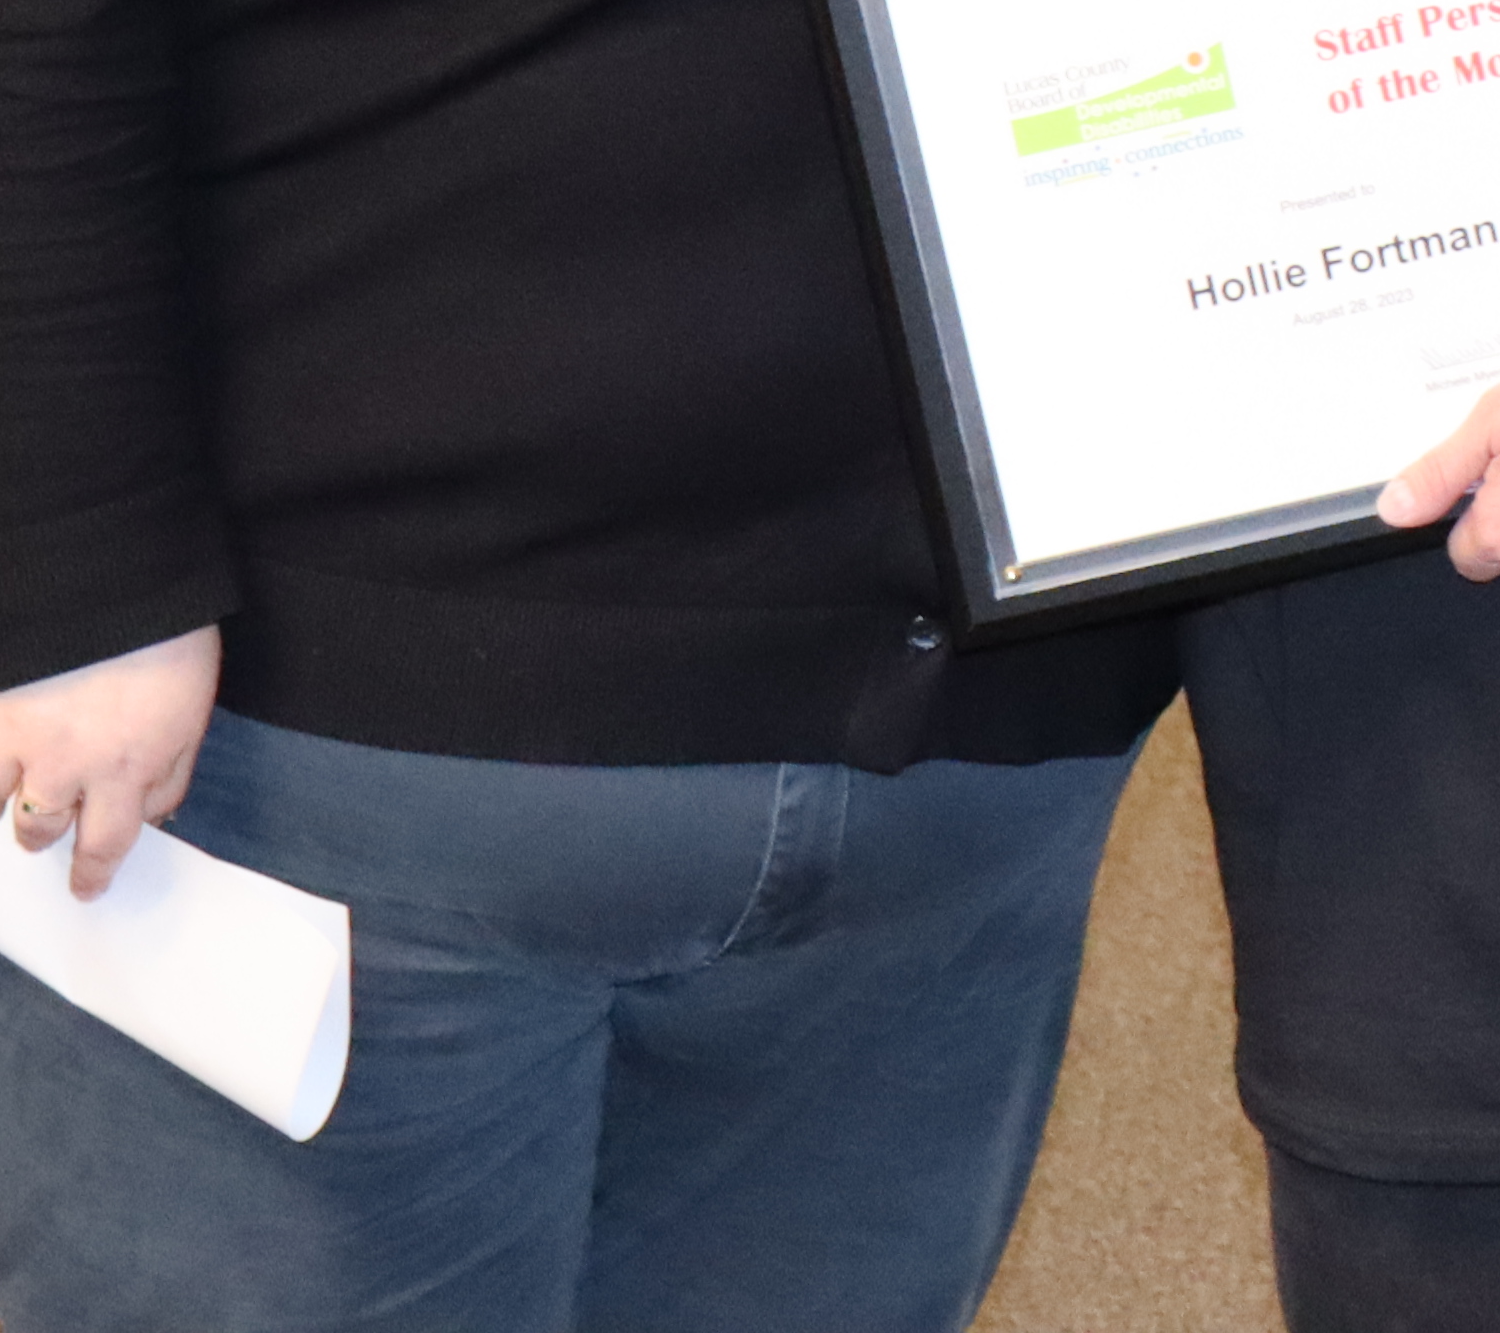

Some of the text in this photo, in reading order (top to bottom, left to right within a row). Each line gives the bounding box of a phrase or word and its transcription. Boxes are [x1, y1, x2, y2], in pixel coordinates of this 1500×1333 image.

[1313, 14, 1405, 62] Staff
[1003, 56, 1130, 96] Lucas County
[1074, 74, 1226, 121] Developmental
[1327, 79, 1365, 115] of
[1378, 68, 1441, 103] the
[1007, 82, 1087, 115] Board of
[1080, 106, 1183, 142] Disabilities
[1023, 125, 1245, 188] inspiring connections
[1280, 180, 1376, 214] Presented to
[1186, 220, 1499, 310] Hollie Fortman
[1292, 303, 1346, 328] August
[1377, 286, 1415, 307] 2023
